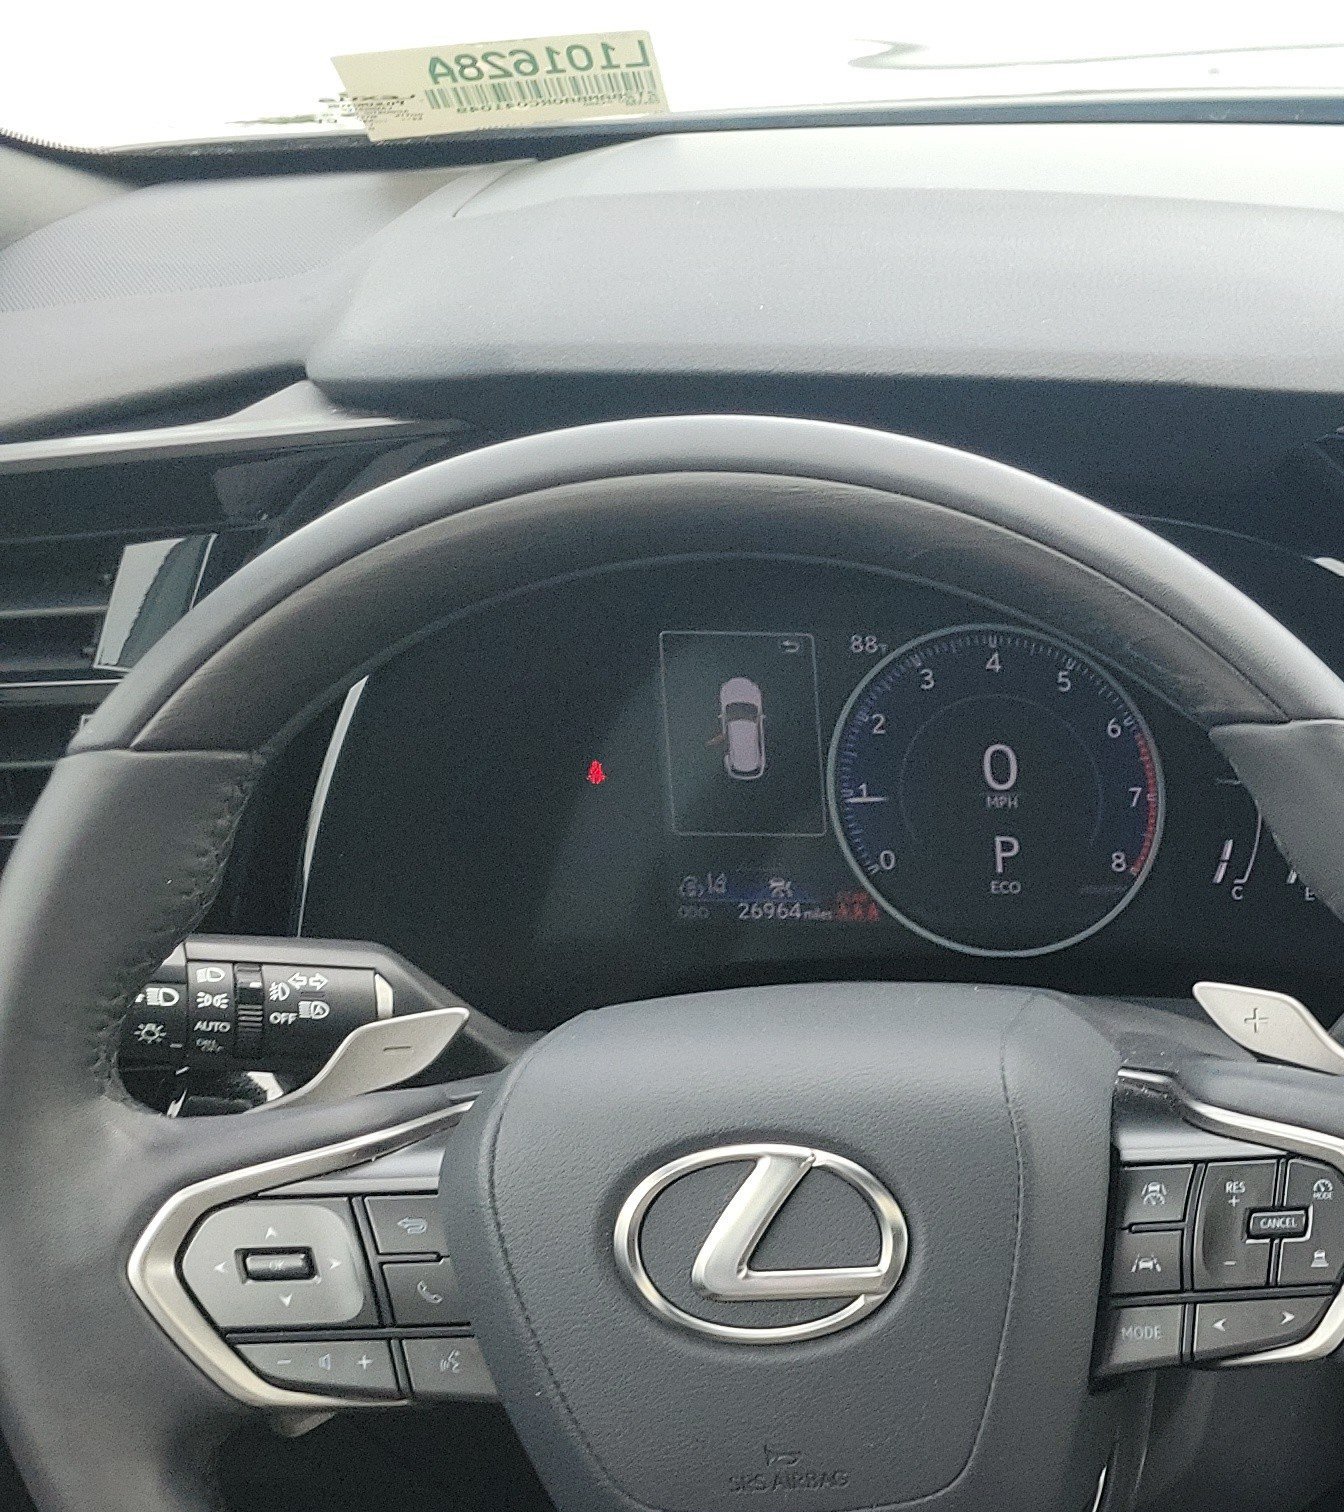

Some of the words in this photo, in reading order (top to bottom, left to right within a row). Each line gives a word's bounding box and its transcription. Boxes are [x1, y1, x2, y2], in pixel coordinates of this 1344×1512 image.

[985, 652, 1001, 673] 4
[919, 668, 935, 690] 3
[1057, 670, 1072, 692] 5
[872, 713, 887, 734] 2
[1107, 718, 1122, 738] 6
[983, 744, 1018, 791] 0
[986, 795, 1019, 809] MPH
[1128, 786, 1143, 808] 7
[880, 850, 896, 870] 0
[994, 835, 1020, 873] P
[1111, 851, 1126, 872] 8
[990, 880, 1022, 895] ECO
[1231, 886, 1244, 901] C
[737, 902, 801, 920] 26964
[193, 1020, 231, 1032] AUTO
[269, 1012, 297, 1025] OFF
[1225, 1181, 1246, 1194] RES
[1259, 1217, 1298, 1229] CANCEL
[1121, 1326, 1162, 1342] MODE
[771, 1469, 850, 1491] AIRBAG
